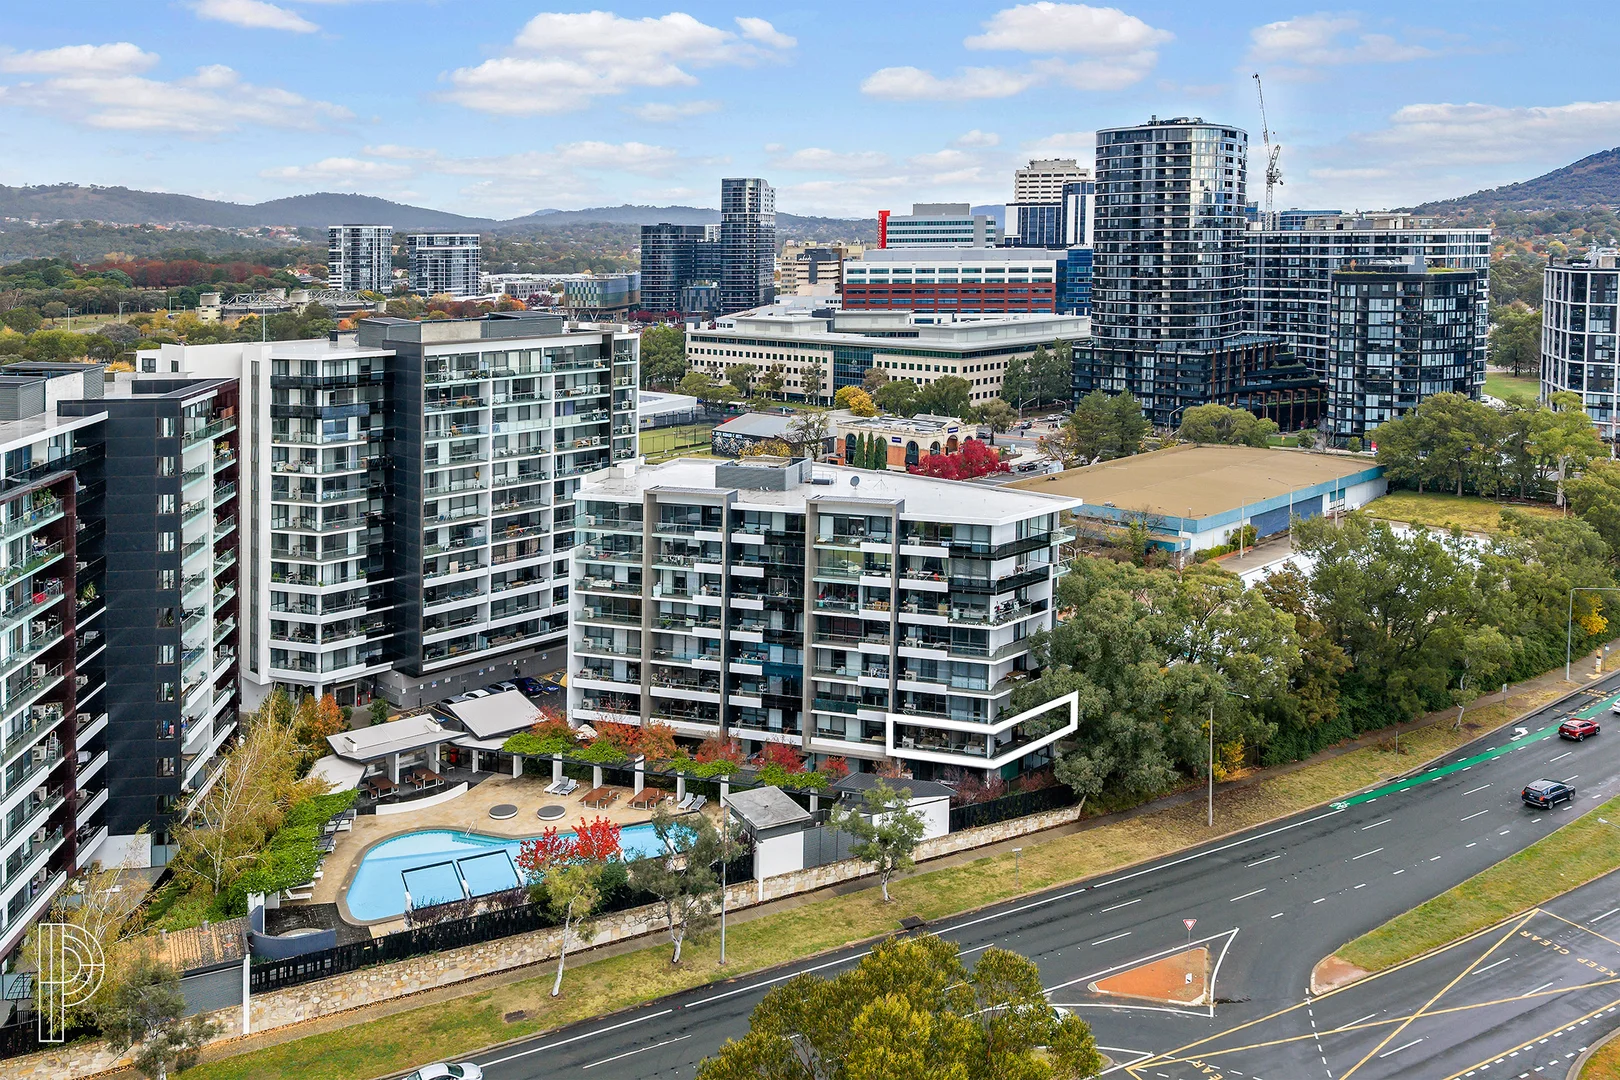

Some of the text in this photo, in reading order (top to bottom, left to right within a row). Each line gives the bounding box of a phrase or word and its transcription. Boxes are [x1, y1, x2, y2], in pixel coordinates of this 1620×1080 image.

[1519, 930, 1618, 977] KEEP CLEAR
[1192, 1060, 1223, 1080] EAR
